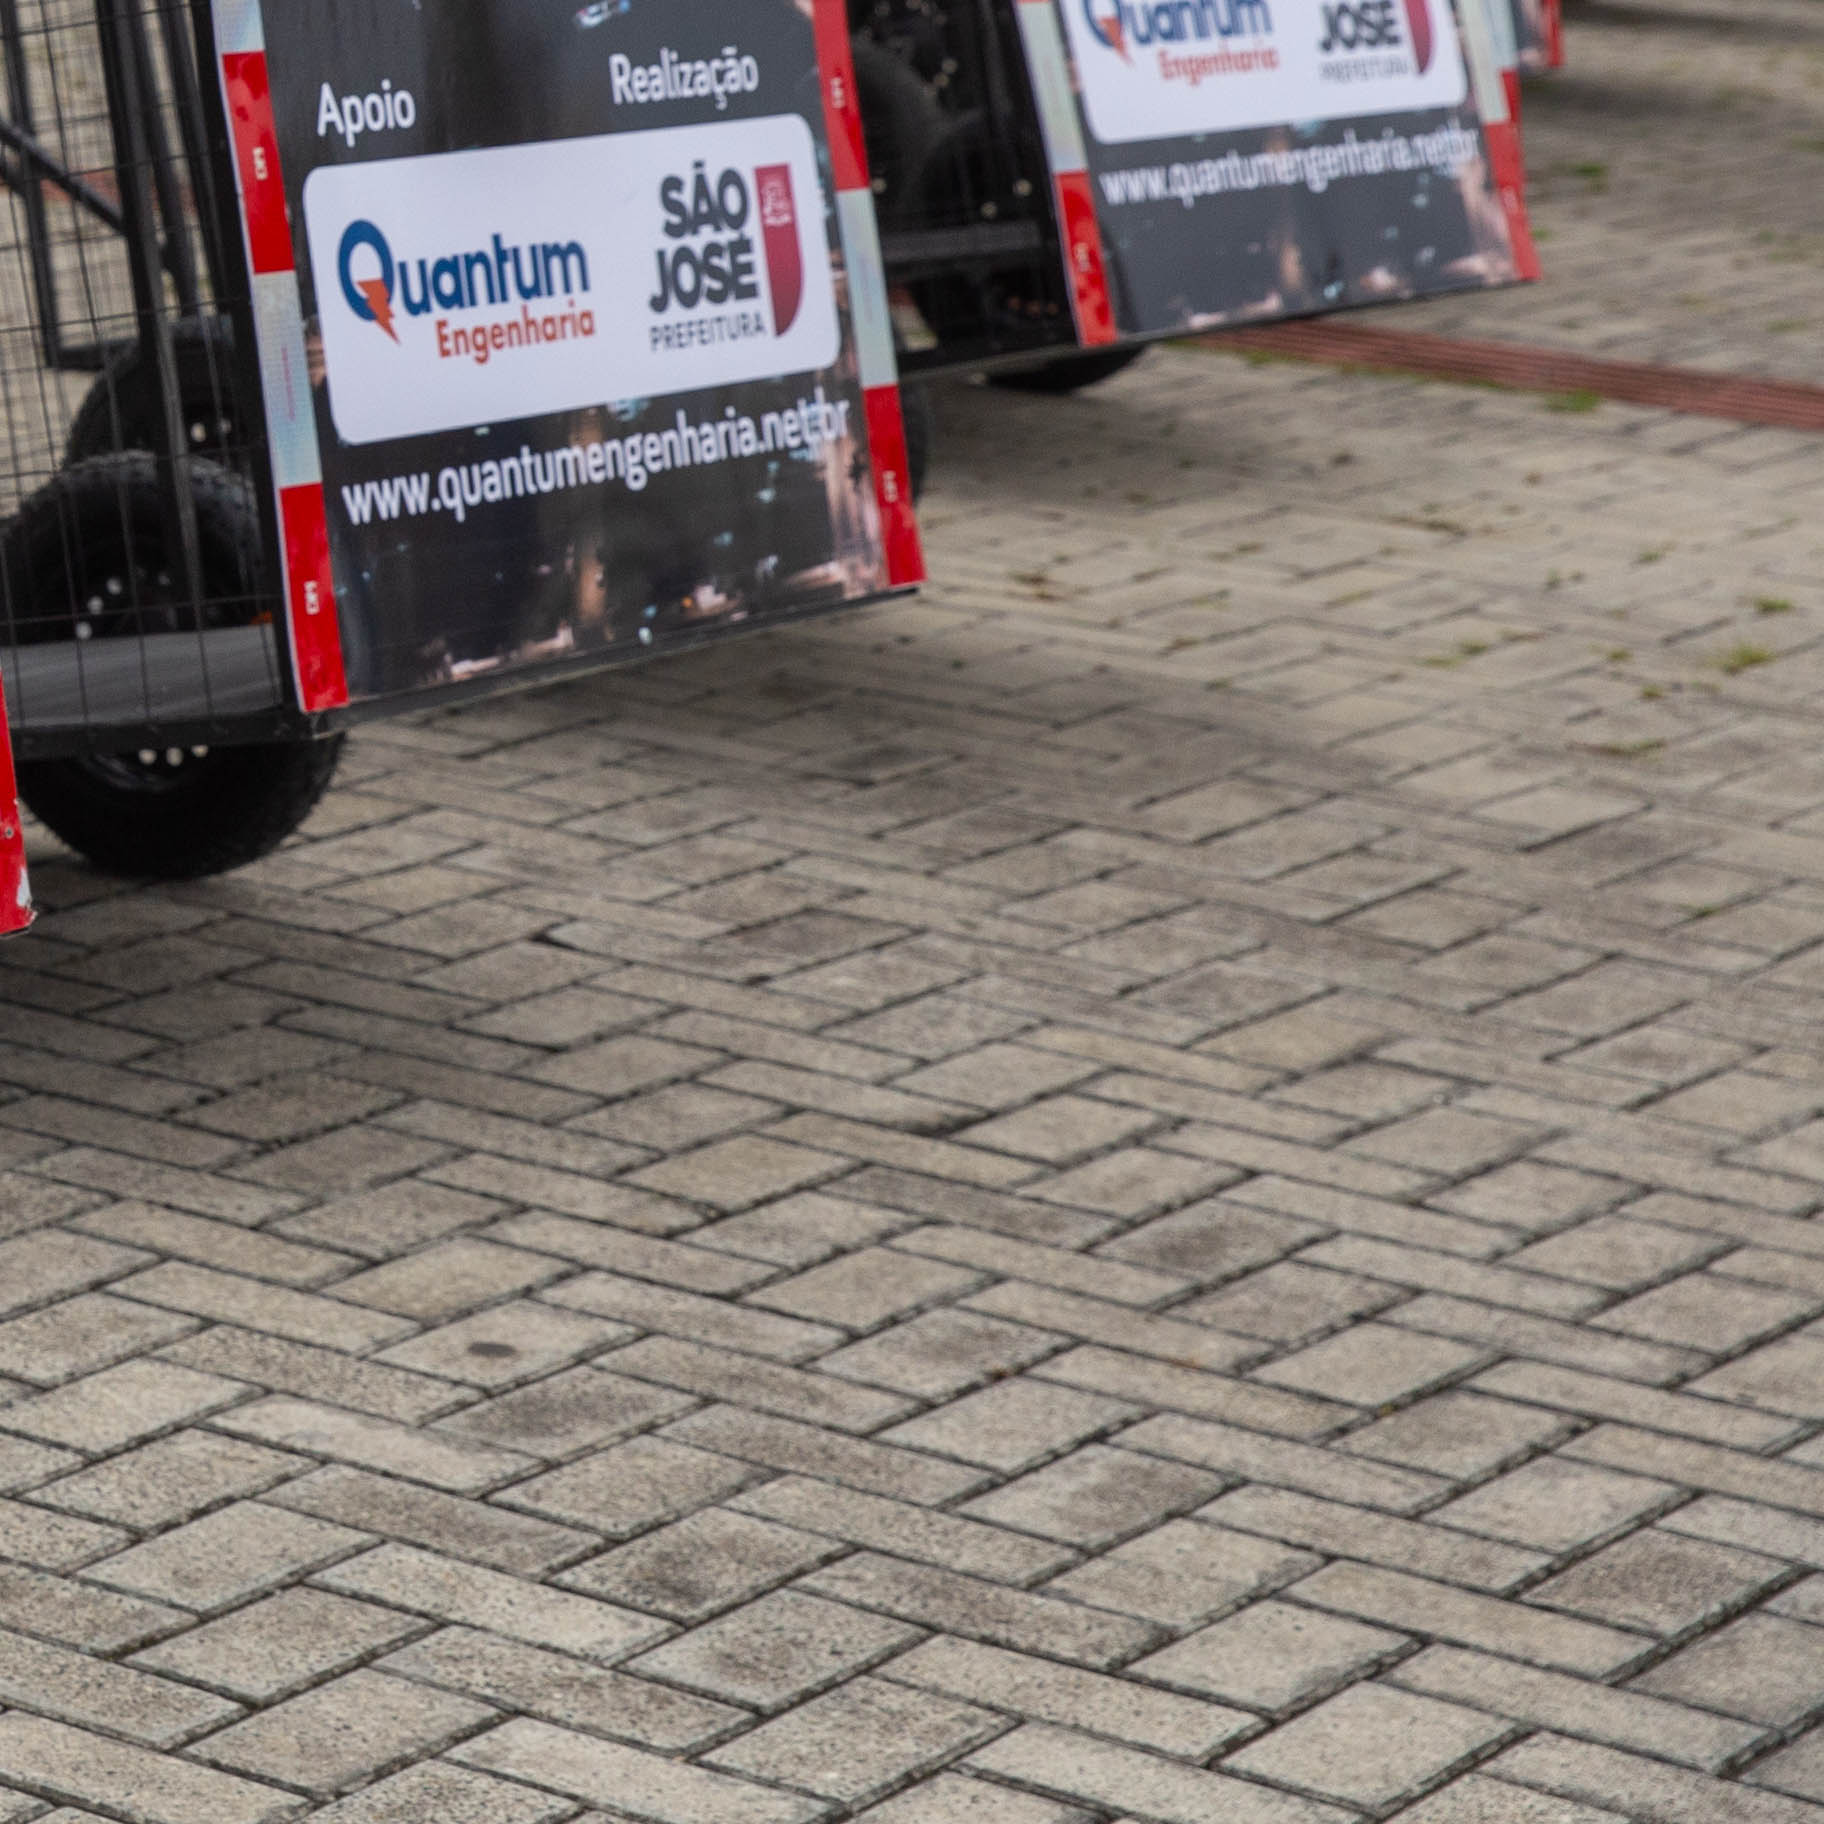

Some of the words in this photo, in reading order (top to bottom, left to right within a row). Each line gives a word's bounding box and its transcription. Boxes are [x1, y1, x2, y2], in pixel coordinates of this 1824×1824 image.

[610, 47, 758, 109] Realização
[318, 80, 415, 146] Apoio
[660, 161, 748, 237] SÃO
[337, 219, 589, 346] Quantum
[650, 233, 758, 313] JOSÉ
[436, 299, 594, 363] Engenharia
[650, 313, 767, 349] PREFEITURA
